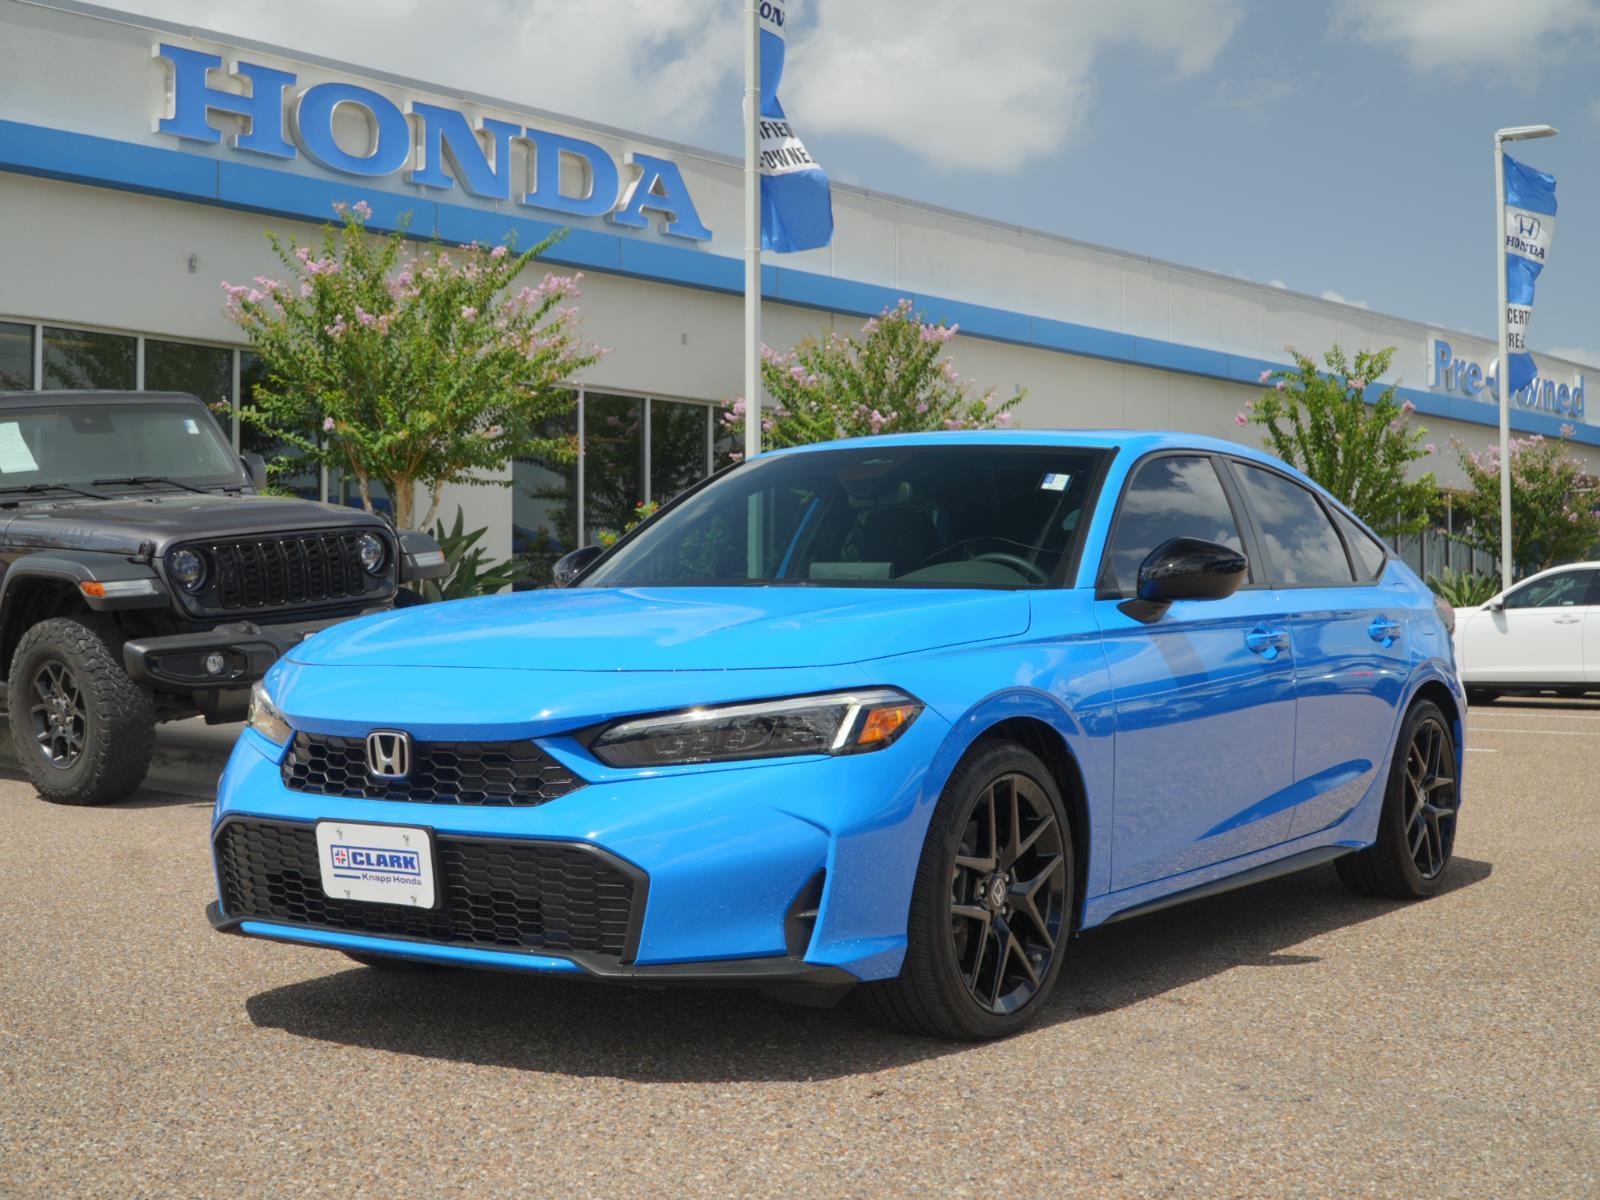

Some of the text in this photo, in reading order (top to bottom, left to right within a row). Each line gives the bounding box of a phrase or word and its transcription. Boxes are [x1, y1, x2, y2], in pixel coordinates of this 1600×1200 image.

[154, 43, 712, 241] HONDA
[1506, 236, 1545, 259] HONDA
[351, 851, 417, 870] CLARK
[361, 873, 422, 886] Knapp Honda
